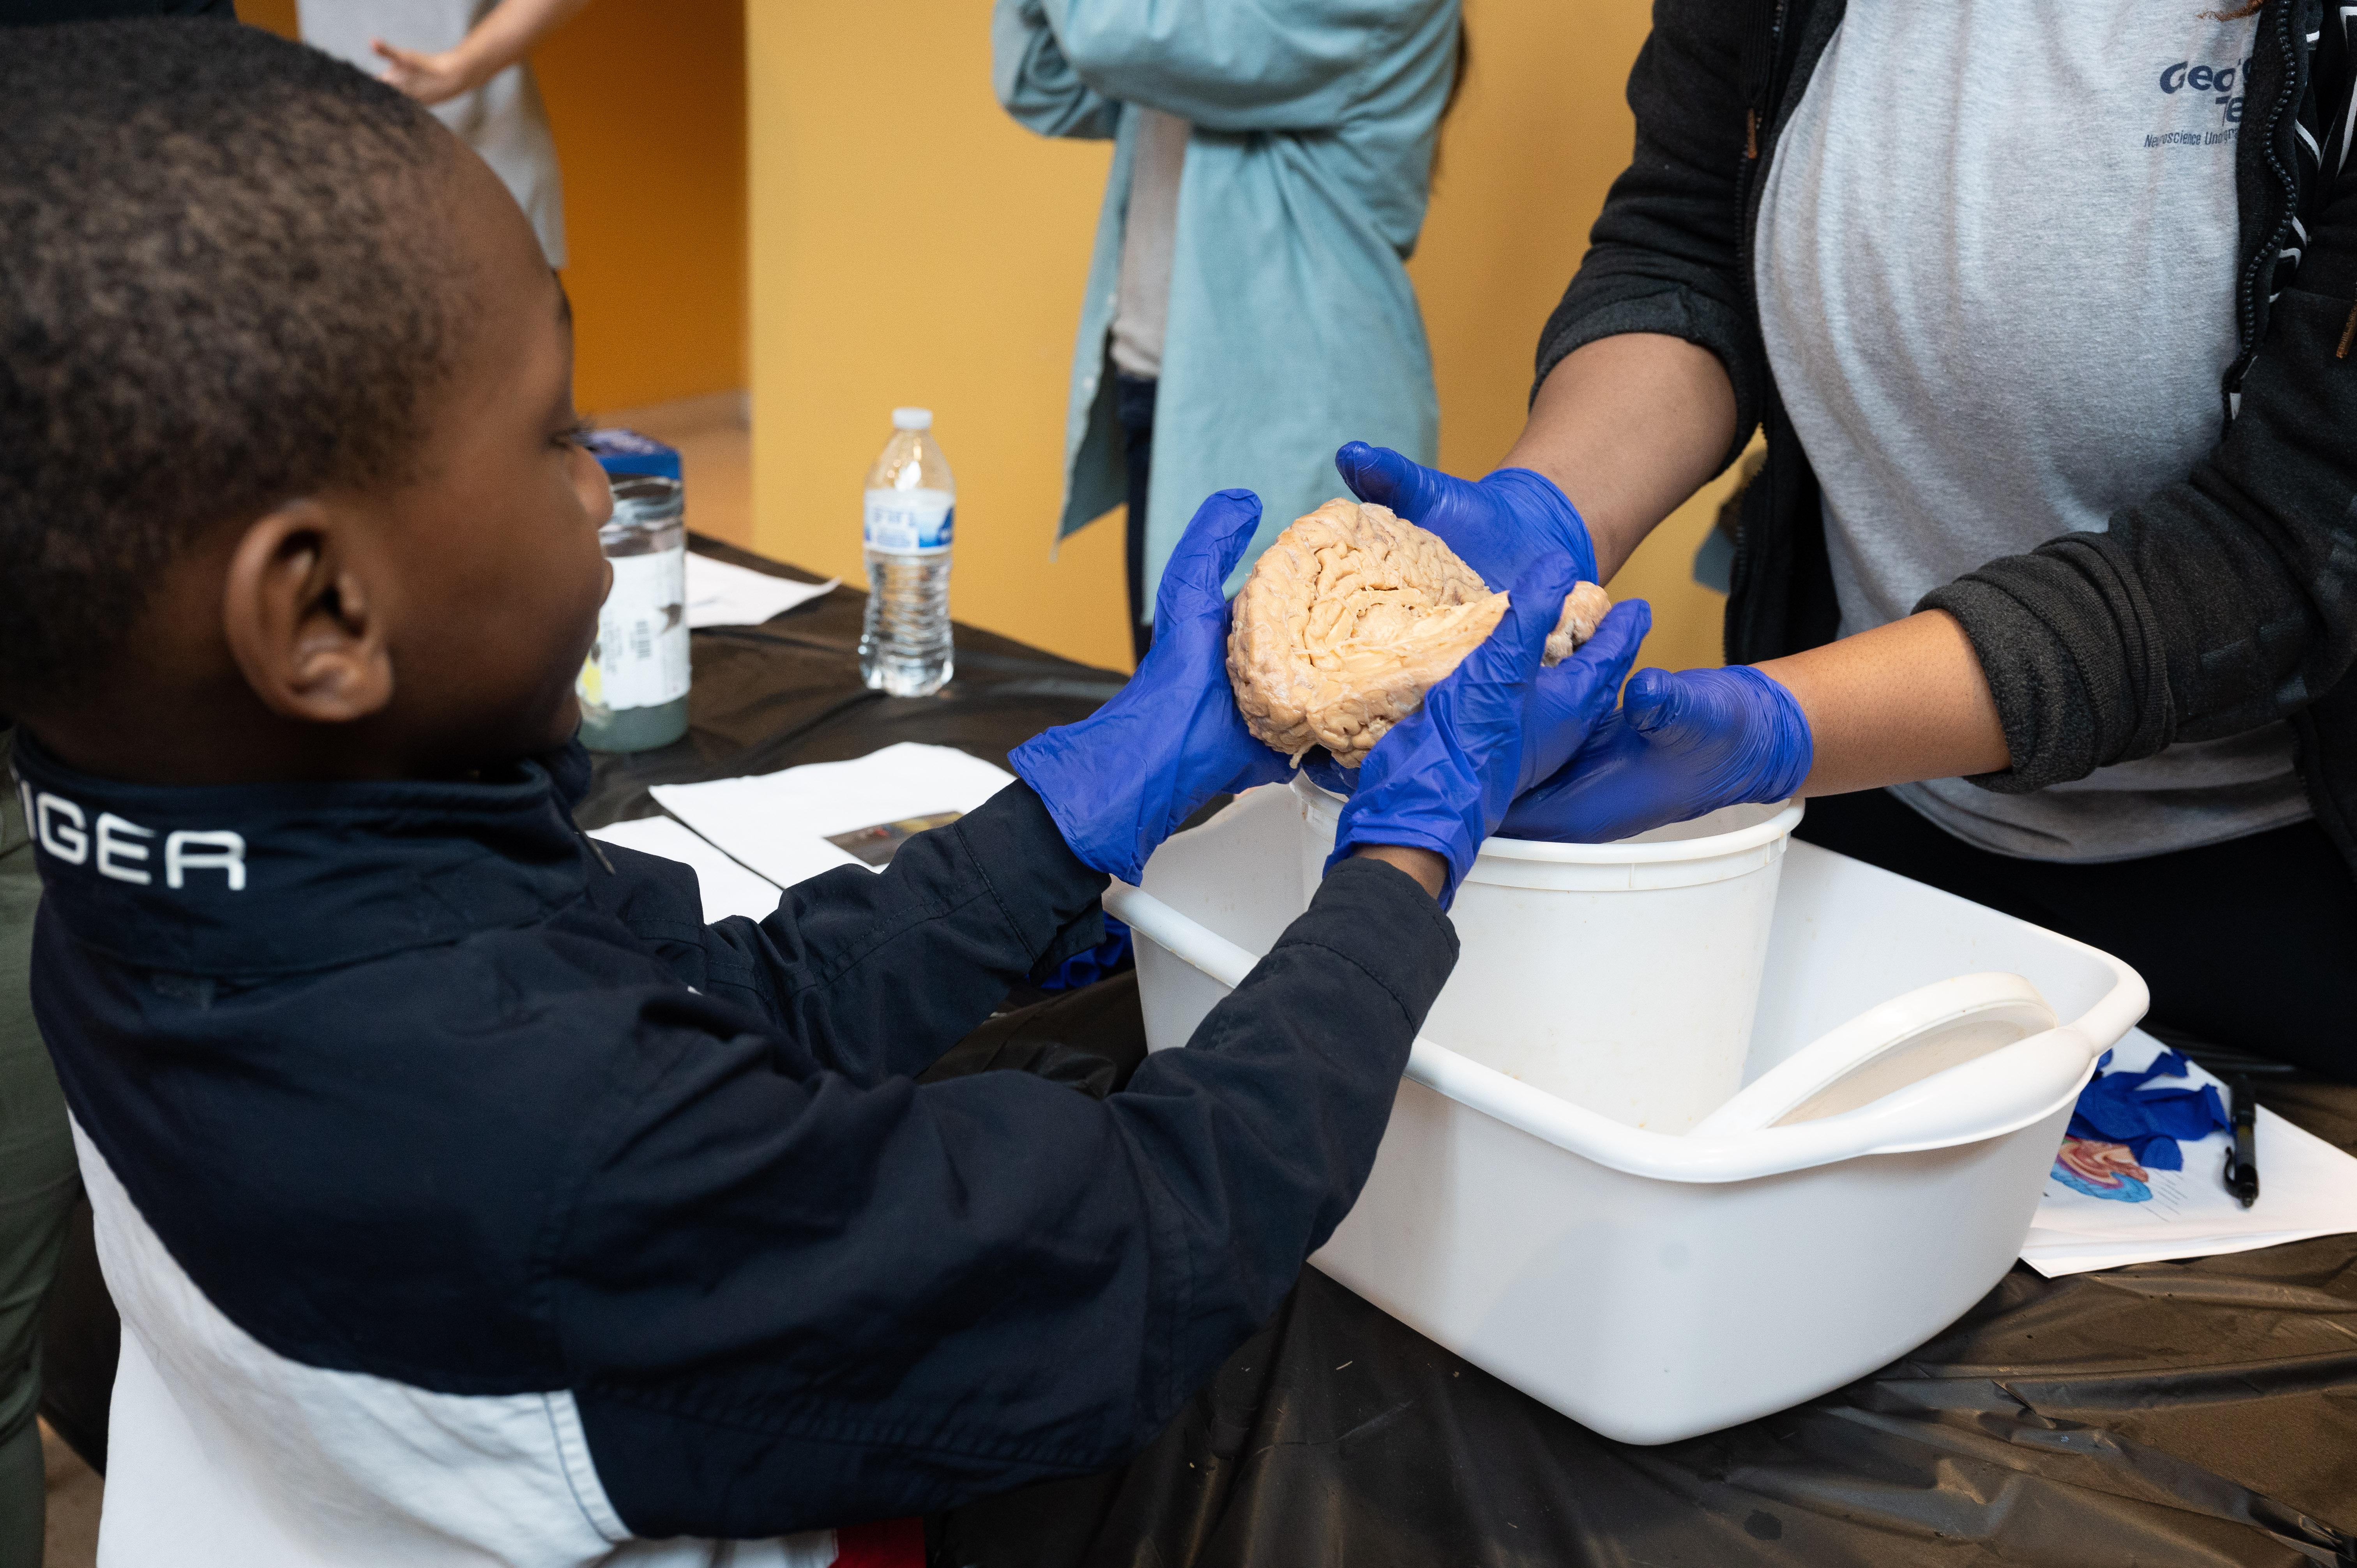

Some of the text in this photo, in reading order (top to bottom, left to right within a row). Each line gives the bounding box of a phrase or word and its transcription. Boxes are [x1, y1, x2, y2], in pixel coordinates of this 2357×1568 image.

[2159, 57, 2252, 94] Geo
[2144, 130, 2201, 146] Neoscience
[10, 765, 247, 891] IGER
